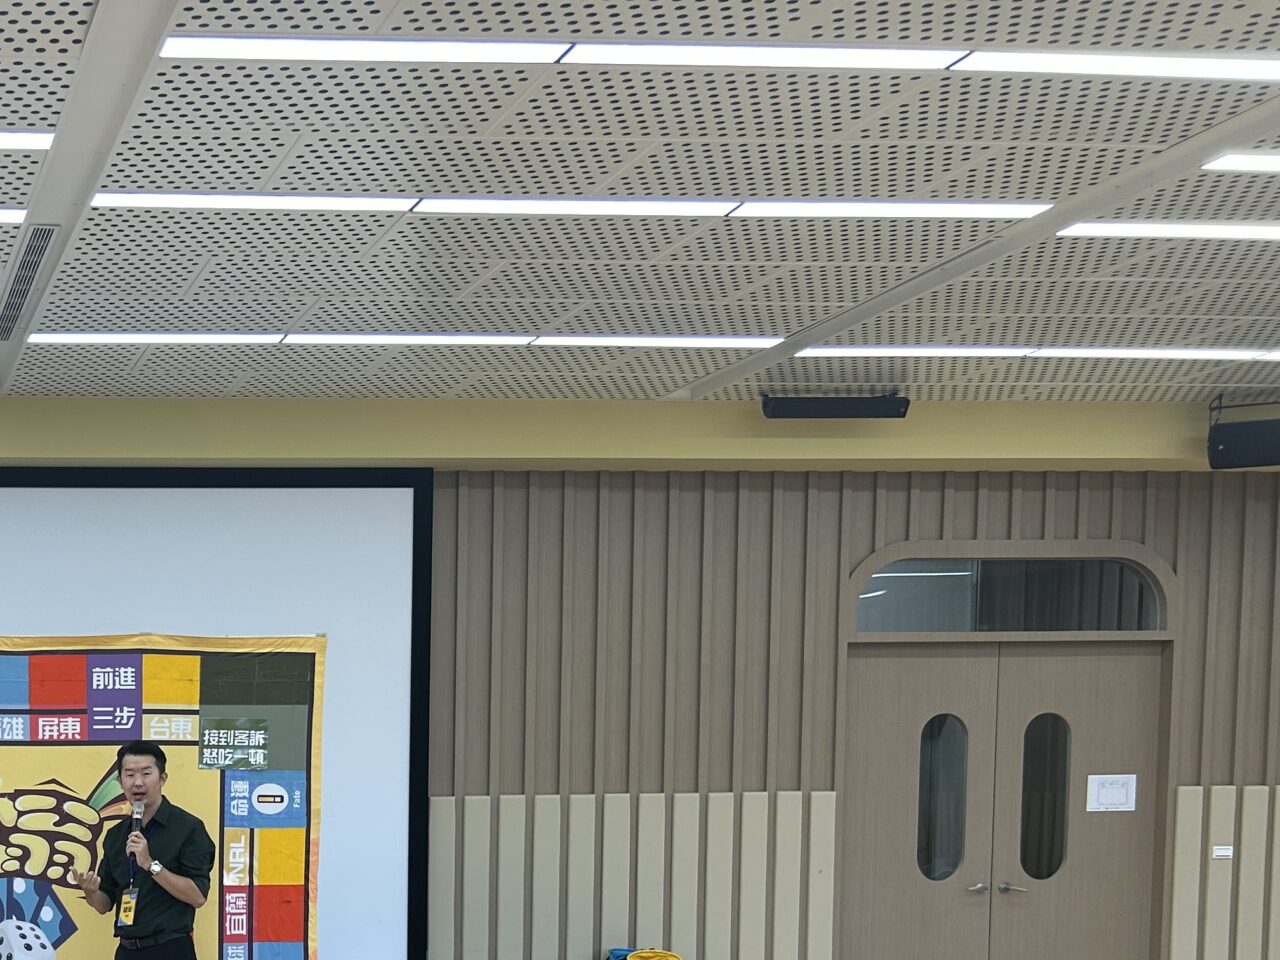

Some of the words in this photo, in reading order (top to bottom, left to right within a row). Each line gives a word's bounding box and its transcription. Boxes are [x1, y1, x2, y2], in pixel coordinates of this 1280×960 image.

[92, 667, 136, 689] 前進
[38, 717, 81, 740] 屏東
[92, 706, 136, 729] 三步
[149, 717, 192, 740] 台東
[203, 730, 268, 746] 接到客訴
[202, 748, 267, 765] 怒吃一頓
[231, 780, 249, 816] 命運
[225, 893, 247, 935] 宜蘭
